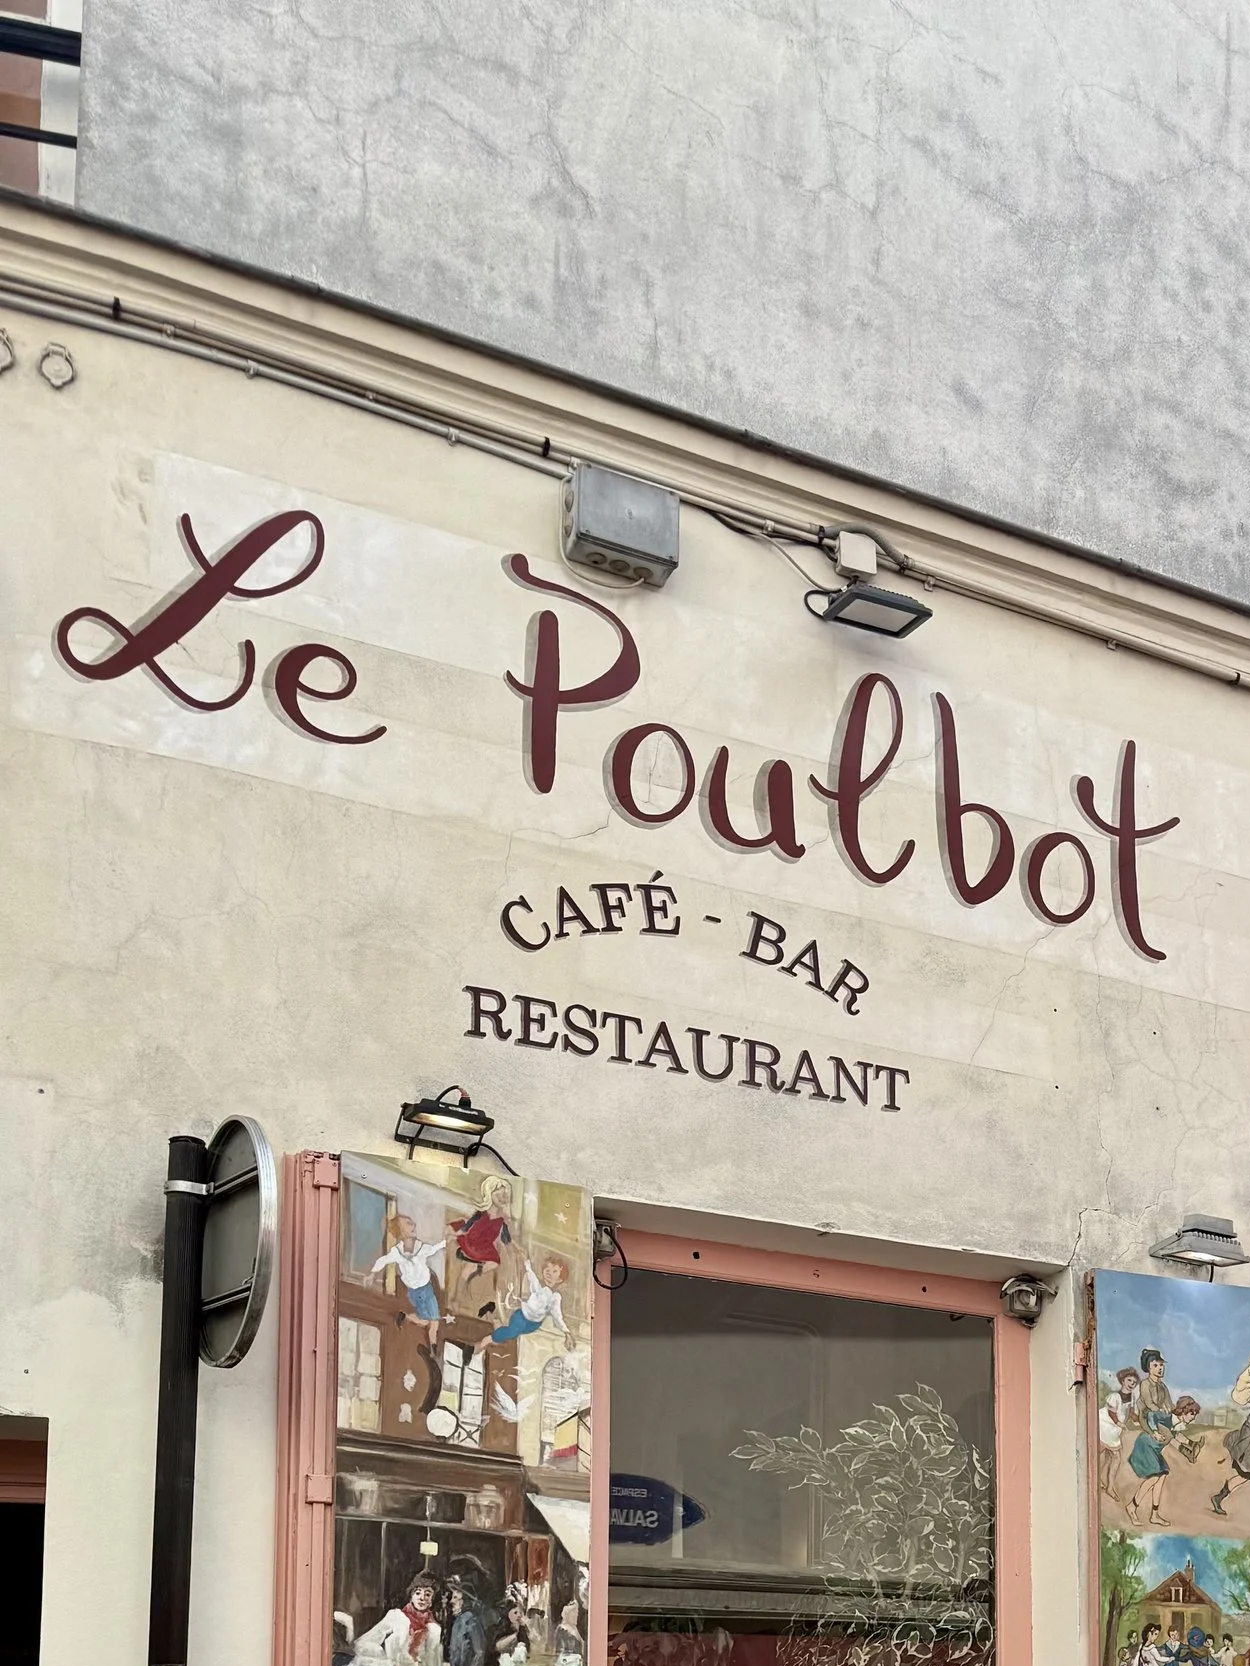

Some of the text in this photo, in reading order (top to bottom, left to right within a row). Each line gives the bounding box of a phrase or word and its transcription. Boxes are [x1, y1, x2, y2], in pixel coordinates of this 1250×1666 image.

[56, 510, 1181, 961] Le Poulbot
[501, 870, 681, 951] CAFÉ
[742, 911, 870, 1016] BAR
[464, 985, 910, 1111] RESTAURANT
